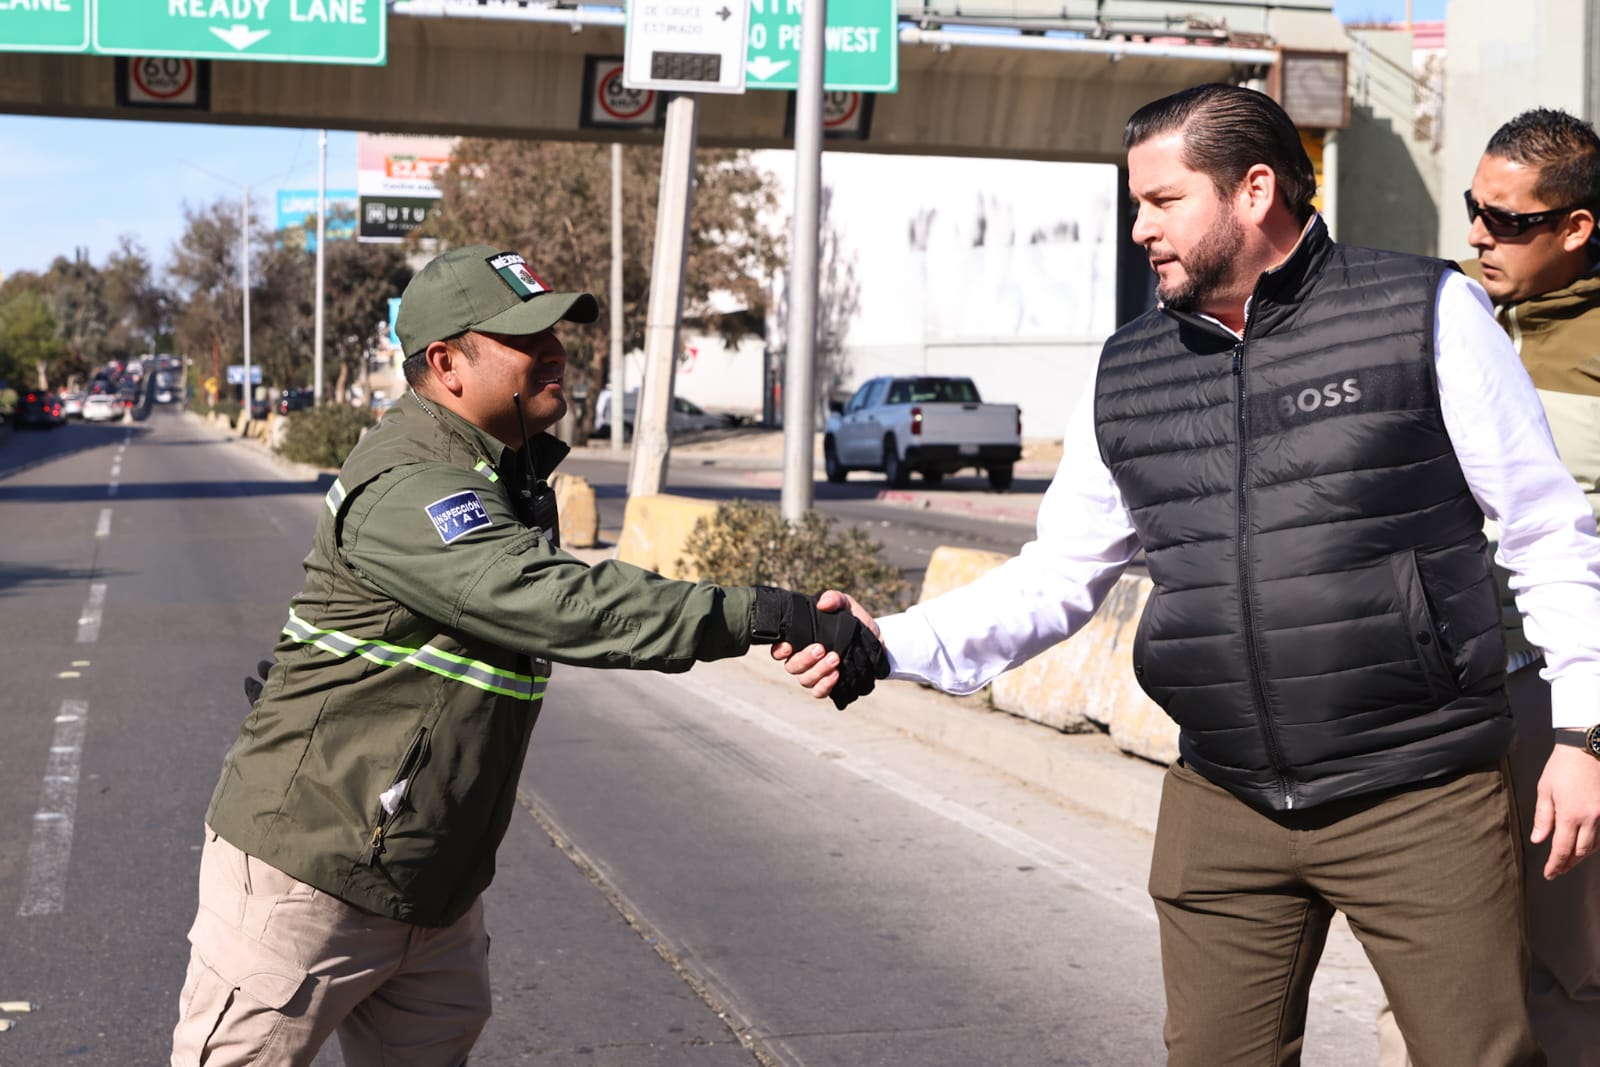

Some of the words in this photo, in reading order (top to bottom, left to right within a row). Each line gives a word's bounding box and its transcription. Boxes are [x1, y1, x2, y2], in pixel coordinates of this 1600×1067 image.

[168, 0, 269, 20] READY
[290, 0, 367, 24] LANE
[1278, 378, 1362, 417] BOSS
[433, 500, 481, 525] INSPECCIÓN
[439, 509, 486, 533] VIAL
